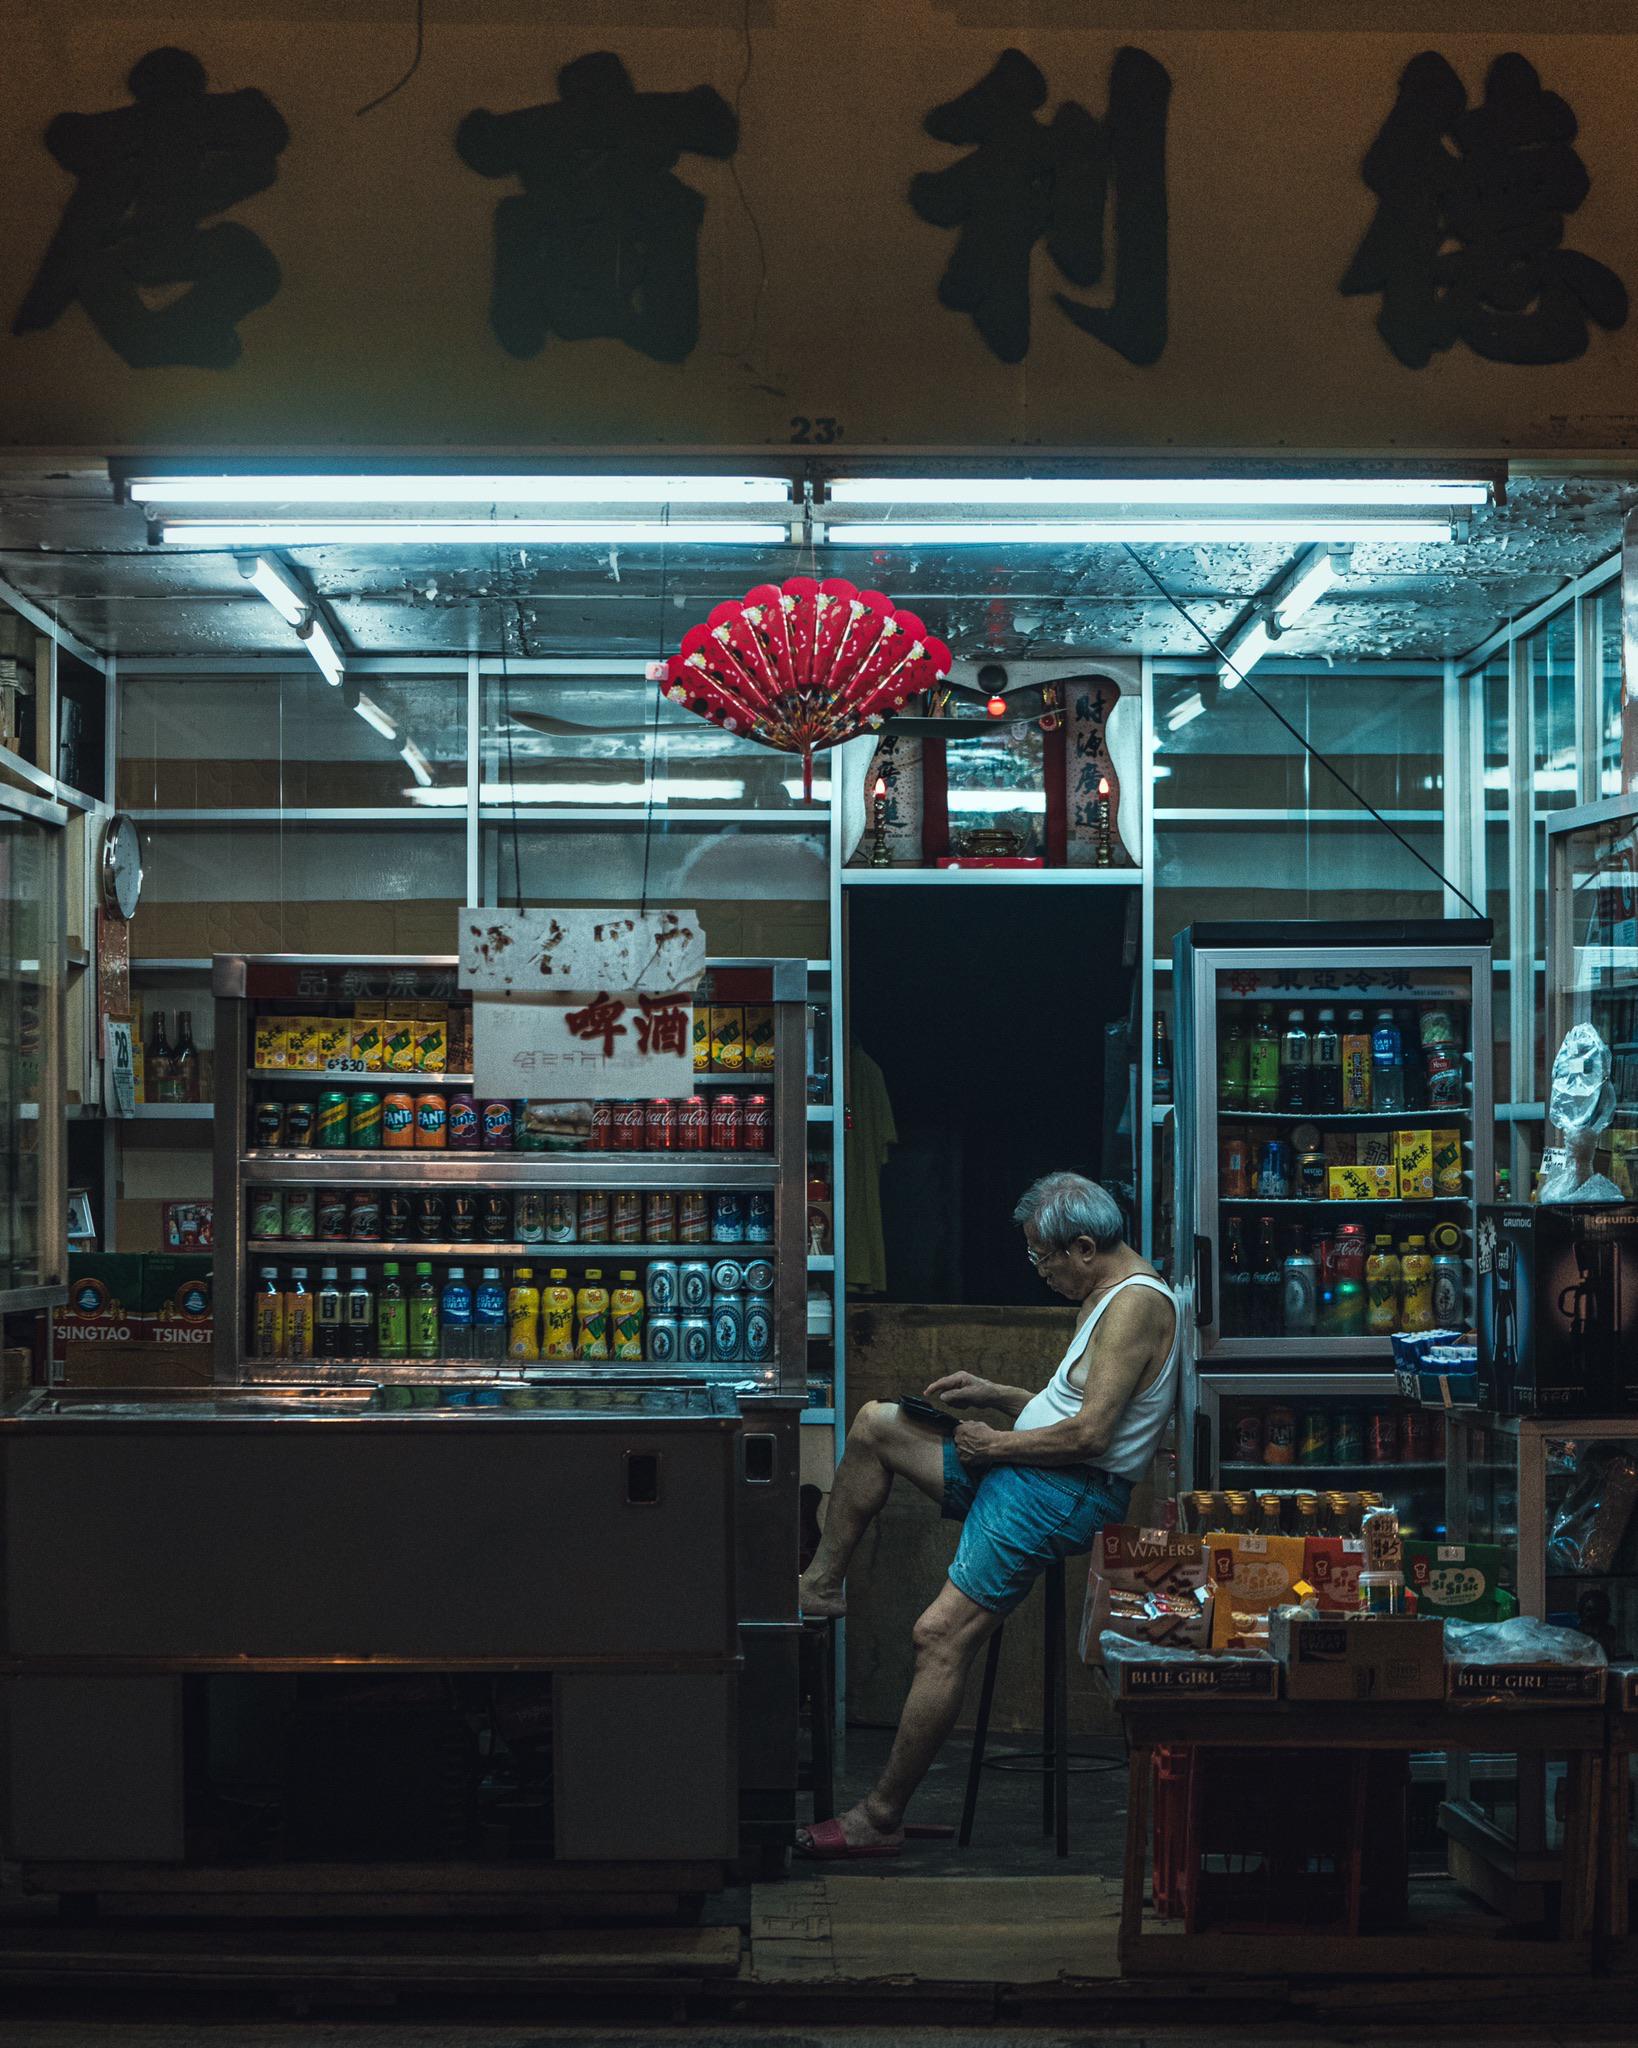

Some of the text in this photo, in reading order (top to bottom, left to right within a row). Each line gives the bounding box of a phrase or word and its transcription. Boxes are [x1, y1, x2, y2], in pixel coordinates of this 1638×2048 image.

[564, 991, 692, 1058] 啤酒
[115, 1031, 129, 1068] 28
[1503, 1217, 1532, 1229] GRUNDIG
[1594, 1215, 1638, 1225] GRUND
[152, 1328, 213, 1343] TSINGT
[1131, 1671, 1174, 1685] BLUE
[1178, 1671, 1218, 1685] GIRL
[1457, 1673, 1545, 1688] BLUE GIRL
